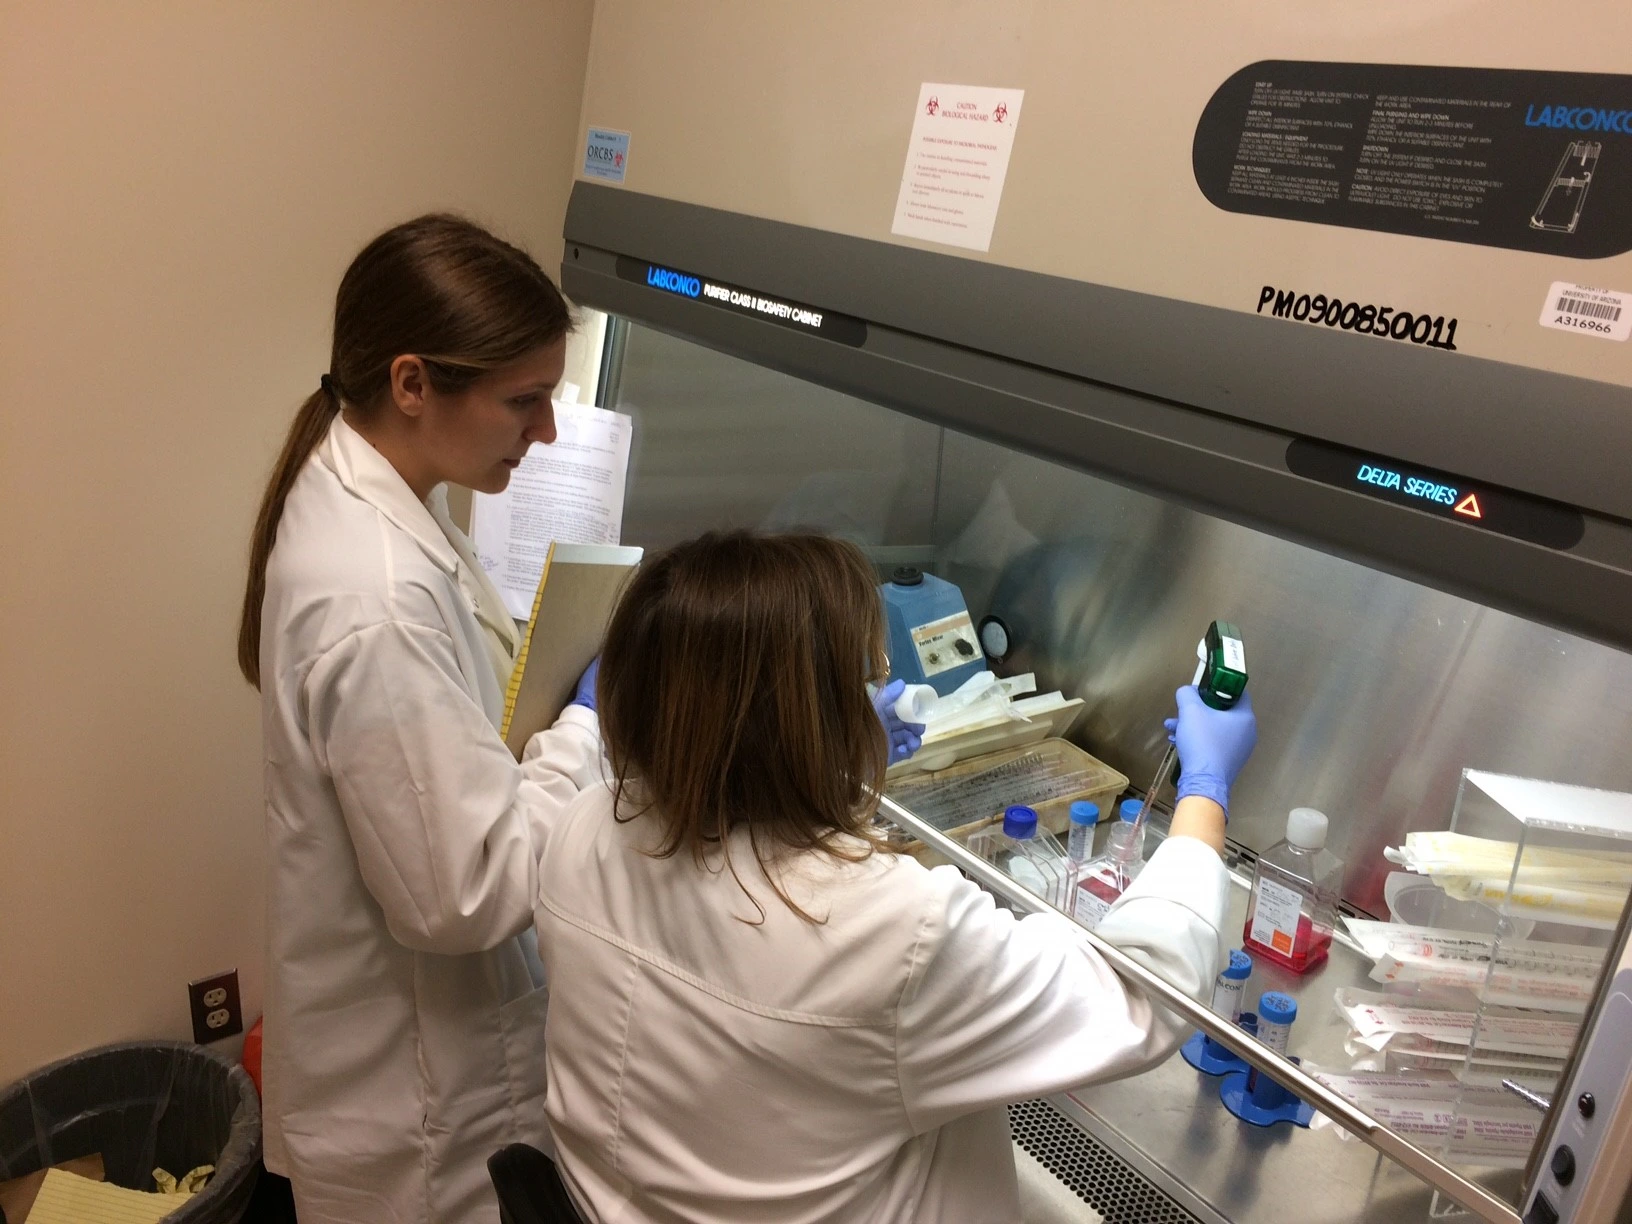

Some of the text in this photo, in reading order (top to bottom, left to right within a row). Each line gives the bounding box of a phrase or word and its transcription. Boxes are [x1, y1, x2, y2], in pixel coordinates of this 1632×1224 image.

[588, 145, 613, 161] ORCBS
[648, 266, 700, 297] LABCONCO
[704, 284, 730, 301] PURIFIER
[730, 291, 751, 307] CLASS
[757, 299, 792, 319] BIOSAFETY
[792, 309, 822, 327] CABINET
[1562, 289, 1590, 299] UNIVERSITY
[1600, 296, 1621, 305] ARIZONA
[1257, 286, 1458, 350] PM0900850011
[1555, 316, 1611, 333] A316966
[1356, 464, 1457, 505] DELTA SERIES
